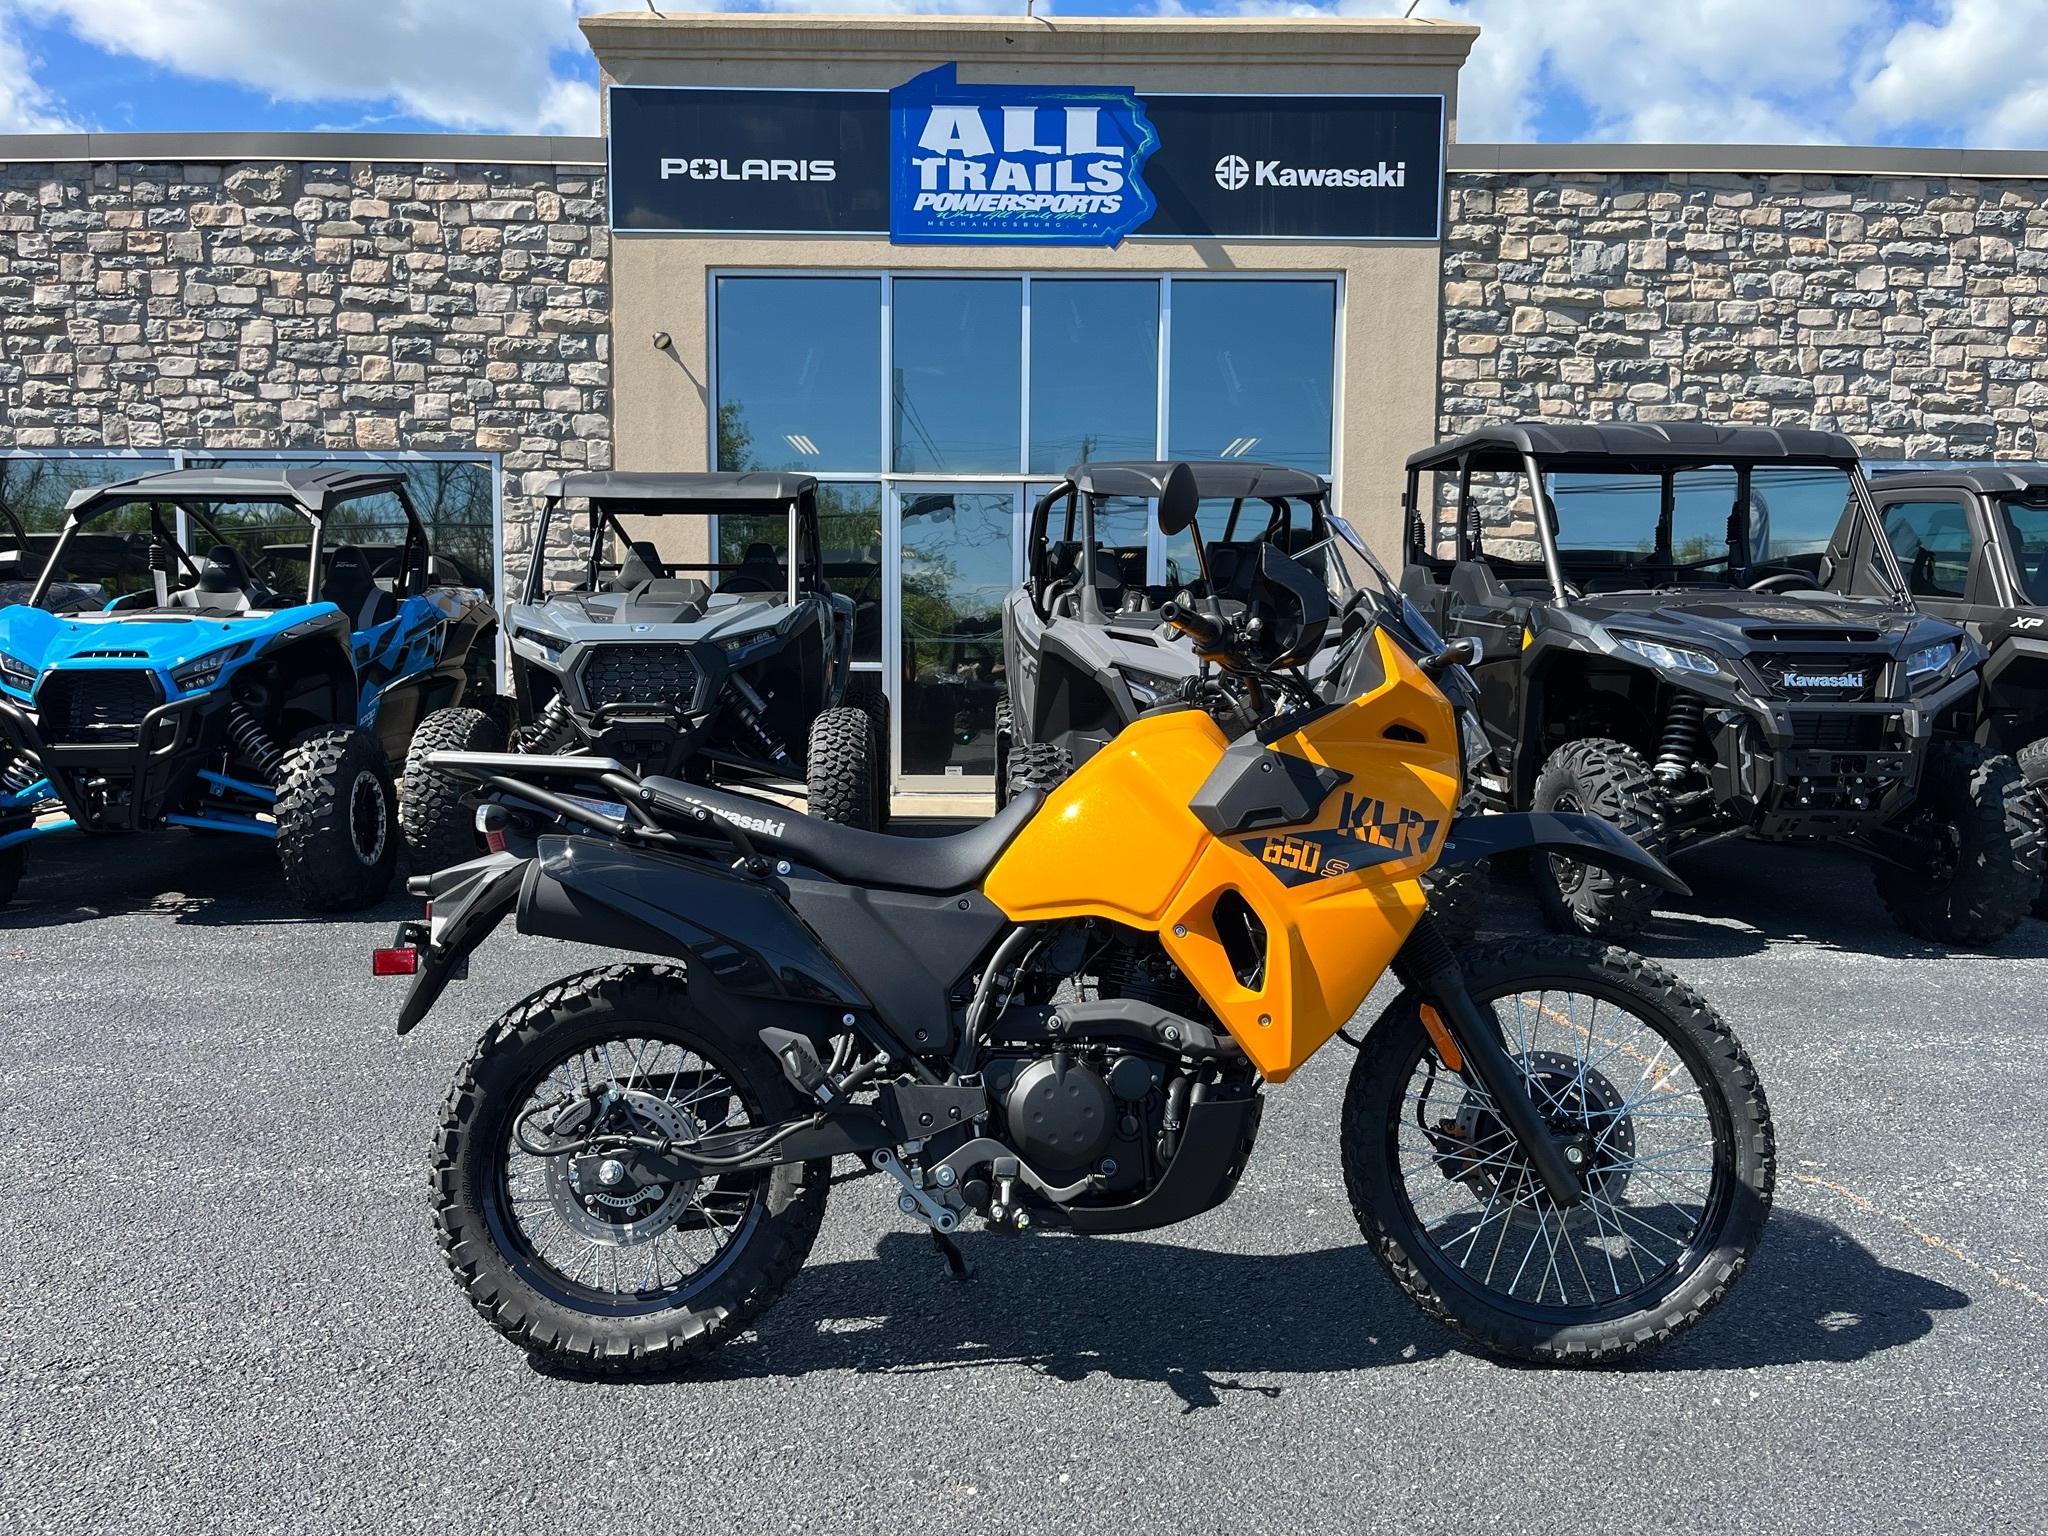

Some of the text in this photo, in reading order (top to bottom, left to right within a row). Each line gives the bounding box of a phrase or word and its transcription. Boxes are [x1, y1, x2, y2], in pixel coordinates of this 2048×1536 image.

[917, 105, 1124, 158] ALL
[661, 158, 837, 181] POLARIS
[912, 157, 1125, 193] TRAILS
[1255, 160, 1406, 187] Kawasaki
[913, 193, 1123, 214] POWERSPORTS
[2009, 616, 2044, 629] XP
[1783, 673, 1863, 687] Kawasaki
[1337, 791, 1425, 857] KLR
[1262, 835, 1350, 879] 650 S
